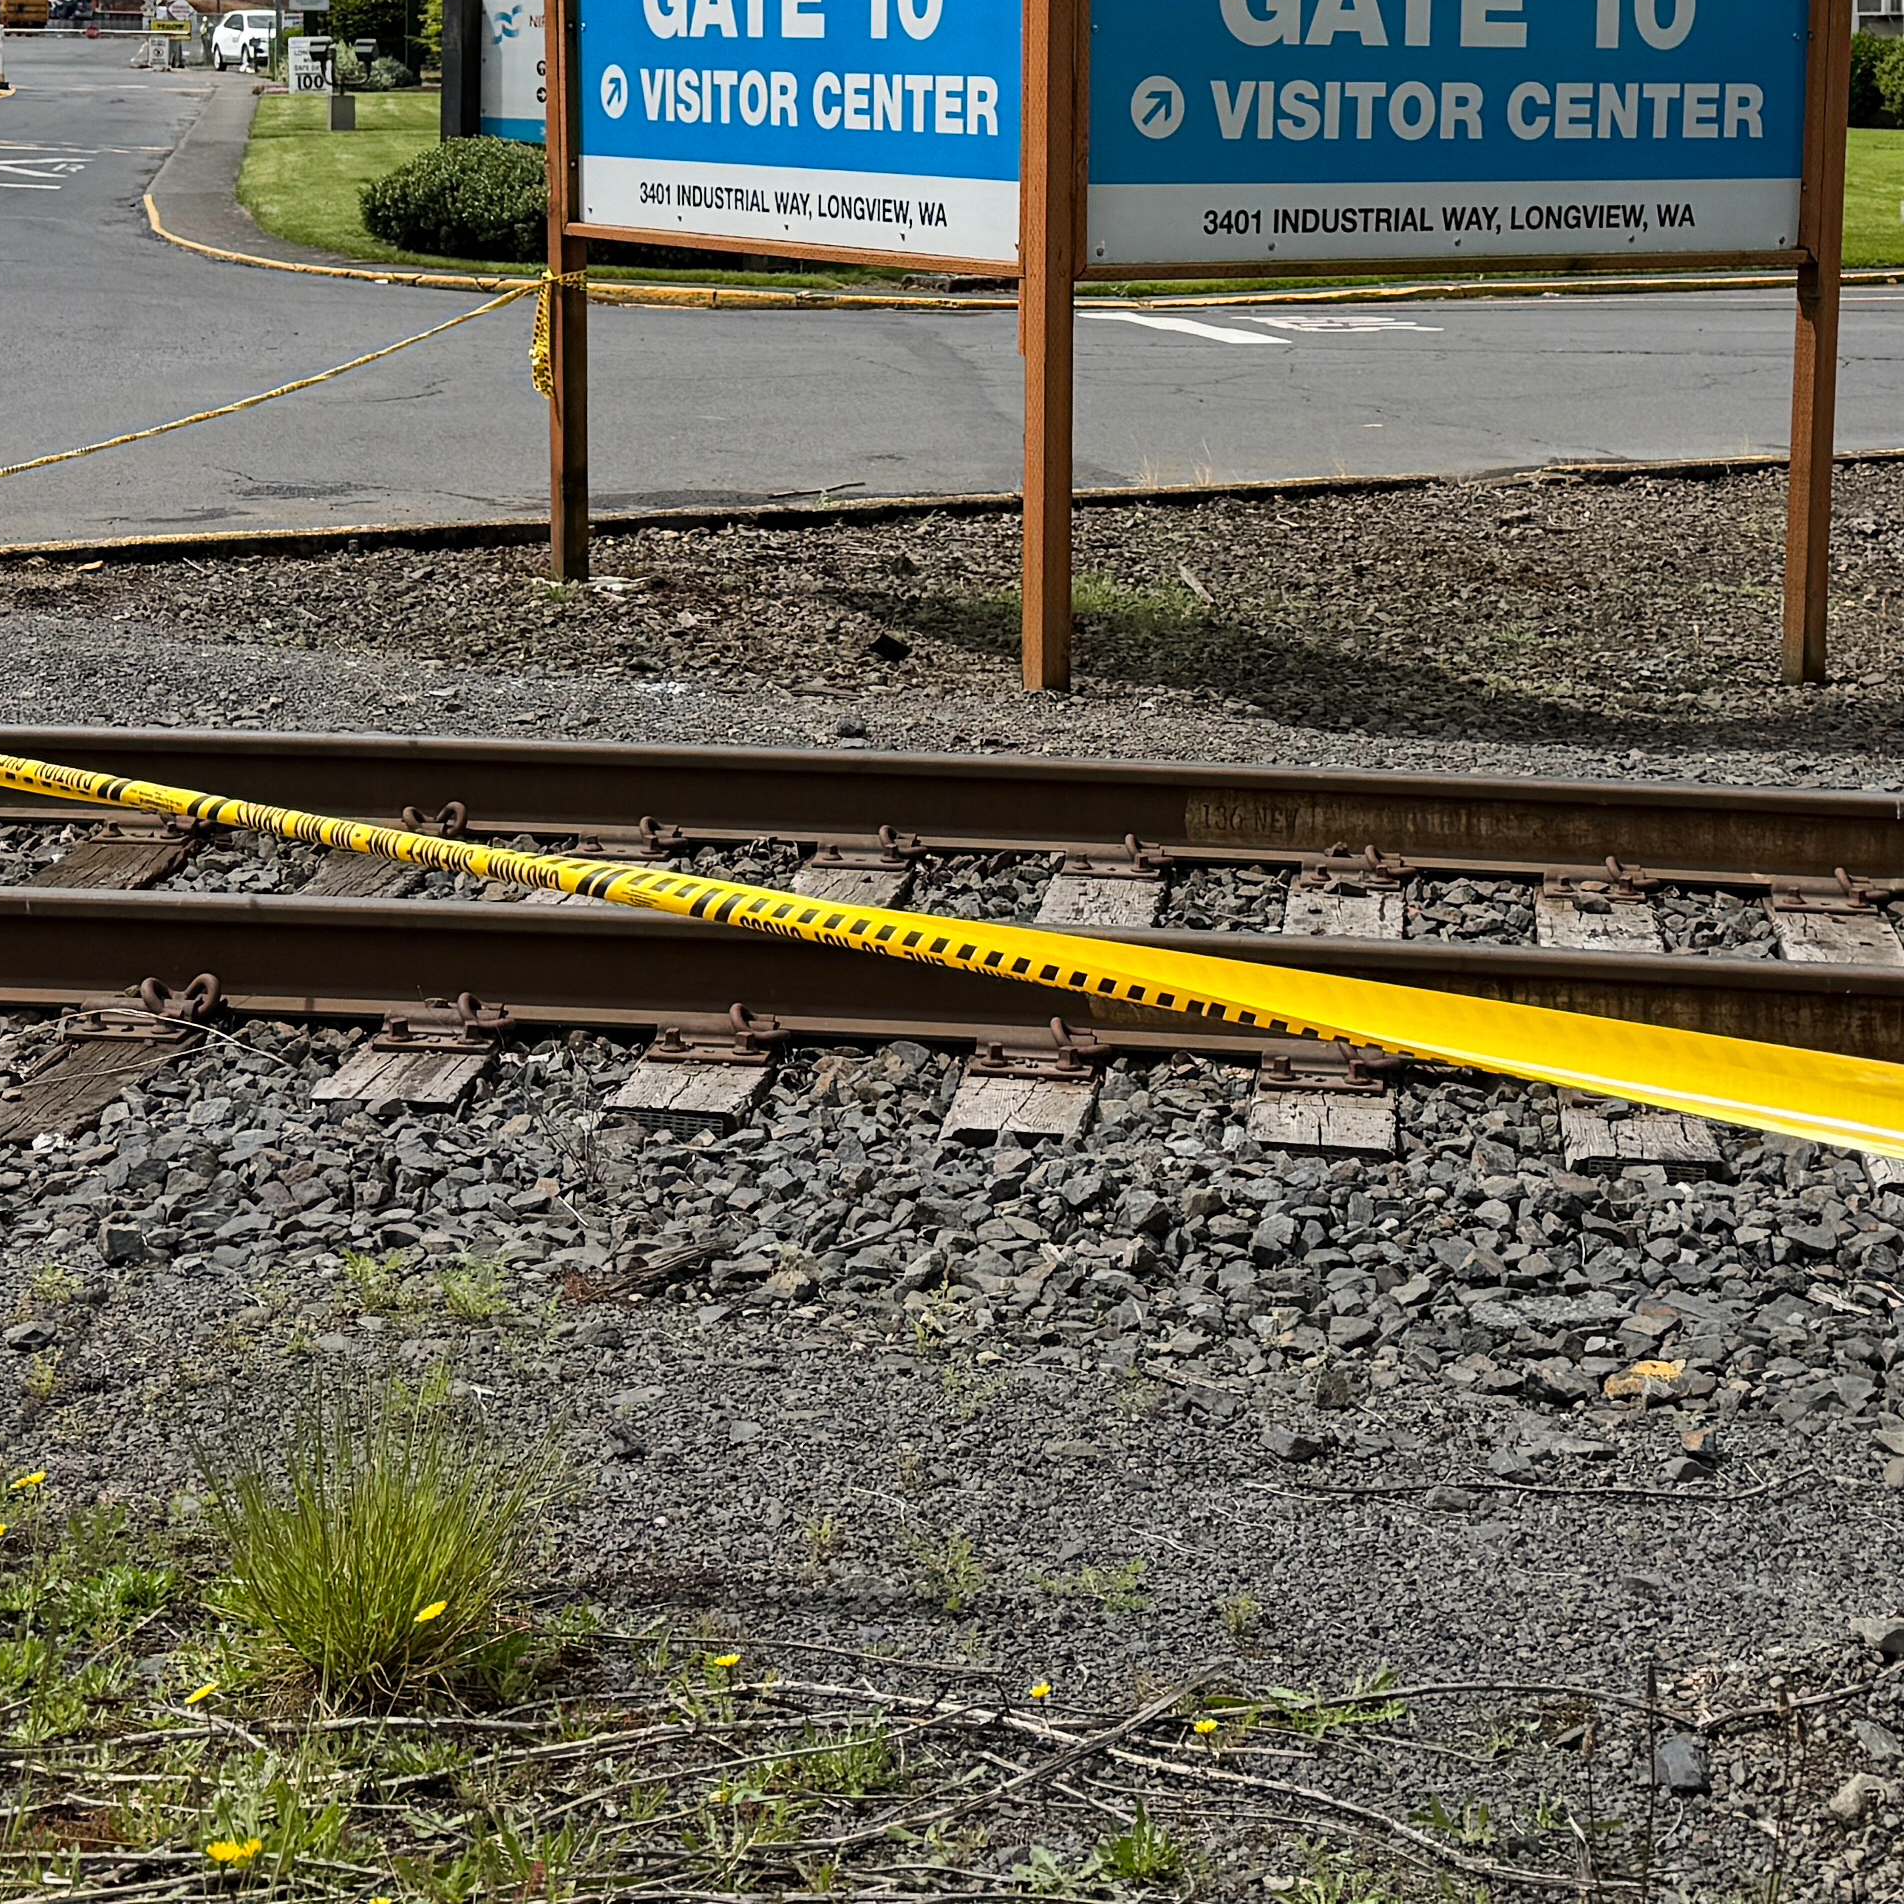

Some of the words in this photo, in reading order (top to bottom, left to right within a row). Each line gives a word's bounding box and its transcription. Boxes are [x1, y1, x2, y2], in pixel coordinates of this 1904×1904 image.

[640, 67, 798, 128] VISITOR
[813, 71, 999, 136] CENTER
[1209, 79, 1483, 140] VISITOR
[1506, 81, 1764, 141] CENTER
[639, 182, 673, 205] 3401
[676, 184, 770, 214] INDUSTRIAL
[774, 190, 813, 221] WAY,
[817, 194, 914, 230] LONGVIEW,
[918, 201, 948, 228] WA
[1202, 208, 1263, 235] 3401
[1273, 206, 1434, 234] INDUSTRIAL
[1441, 205, 1503, 236] WAY,
[1509, 203, 1649, 233] LONGVIEW,
[1655, 202, 1696, 229] WA
